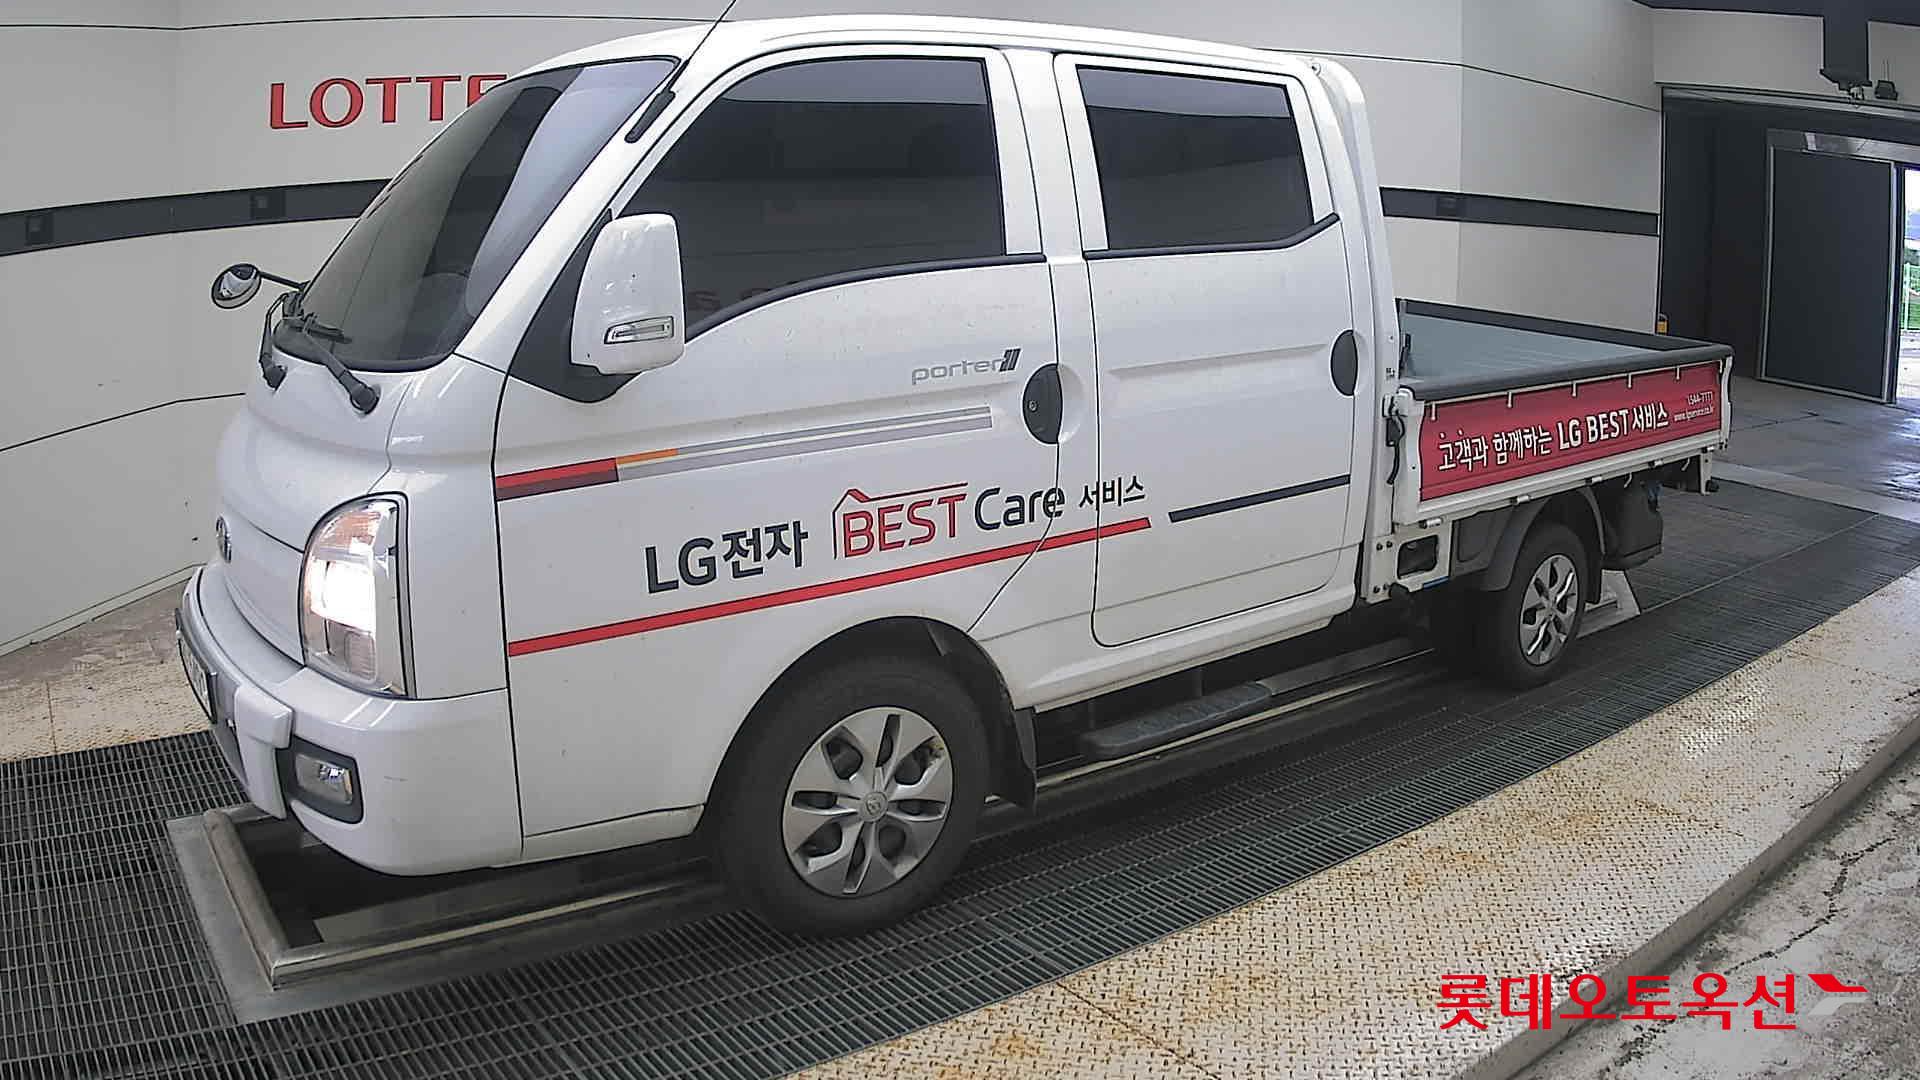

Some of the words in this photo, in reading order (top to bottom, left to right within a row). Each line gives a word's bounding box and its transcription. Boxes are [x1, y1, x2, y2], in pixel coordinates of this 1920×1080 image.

[1438, 429, 1489, 472] 고객과
[1493, 424, 1553, 465] 함께하는
[1557, 420, 1583, 451] LG
[1586, 408, 1630, 443] BEST
[1632, 401, 1670, 433] 서비스
[644, 520, 809, 595] LG전자
[842, 495, 968, 559] BEST
[974, 486, 1066, 531] Care
[1078, 475, 1146, 512] 서비스
